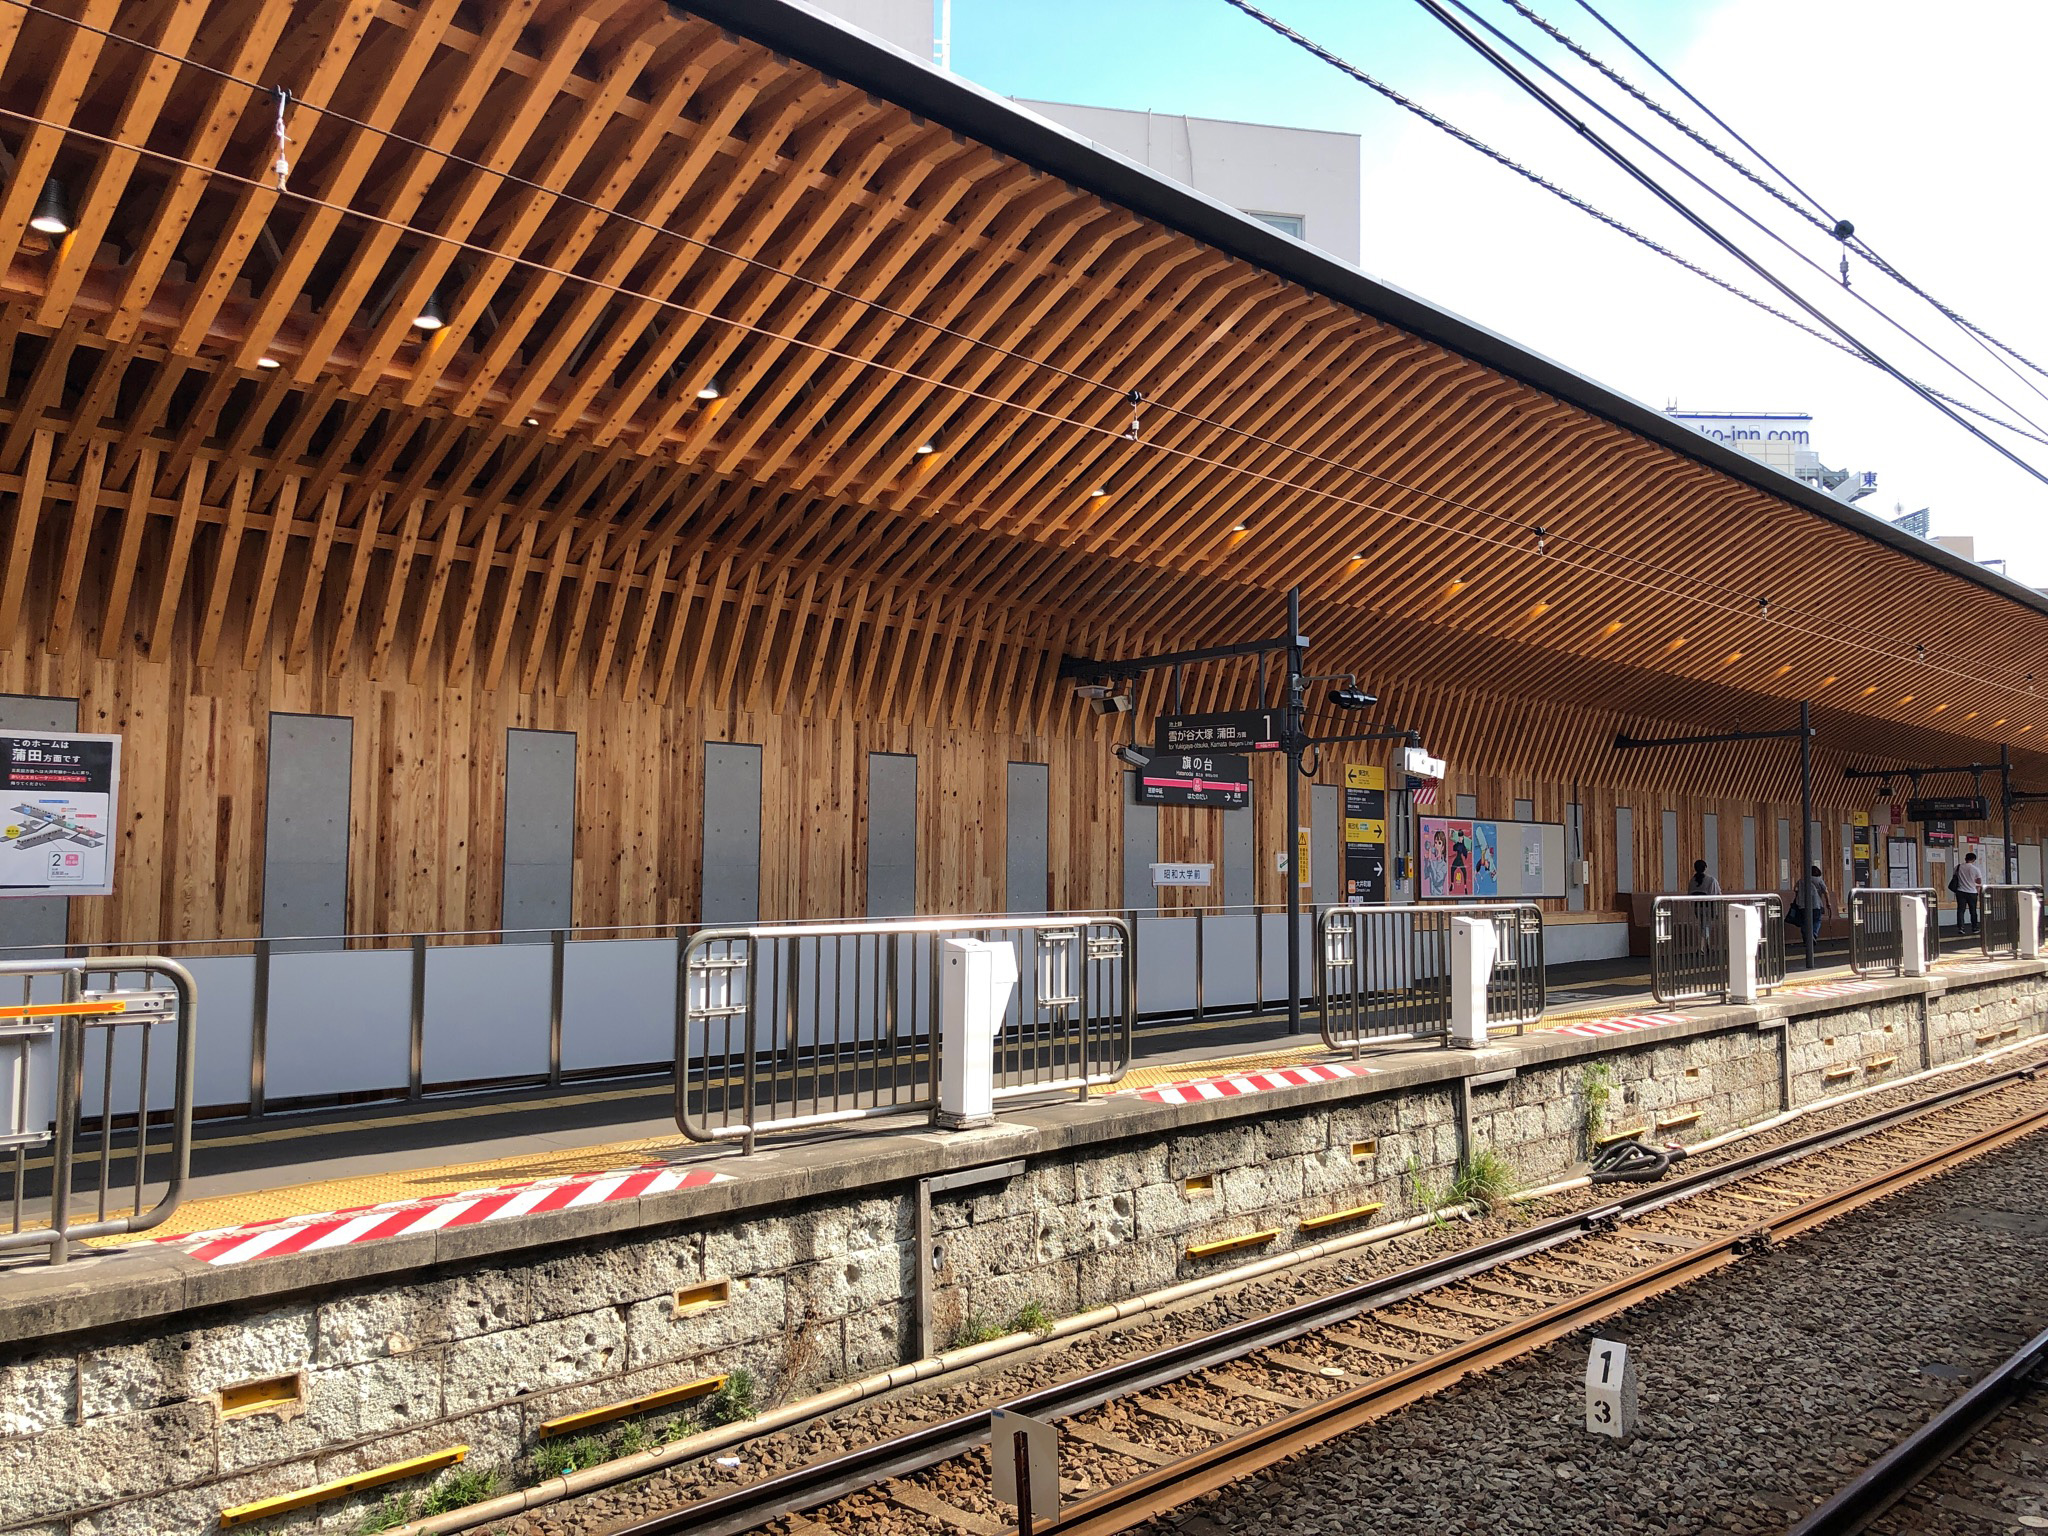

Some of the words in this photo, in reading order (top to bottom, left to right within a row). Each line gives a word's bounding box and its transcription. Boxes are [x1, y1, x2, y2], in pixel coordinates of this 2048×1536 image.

[1862, 471, 1878, 487] 東
[1262, 714, 1271, 741] 1
[1168, 729, 1214, 742] 雪が谷大塚
[12, 739, 70, 749] このホームは
[12, 748, 81, 763] 蒲田方面です
[1182, 756, 1213, 771] 旗の台
[52, 853, 61, 867] 2
[1163, 869, 1201, 880] 昭和大学前
[1600, 1350, 1612, 1383] 1
[1594, 1400, 1611, 1424] 3
